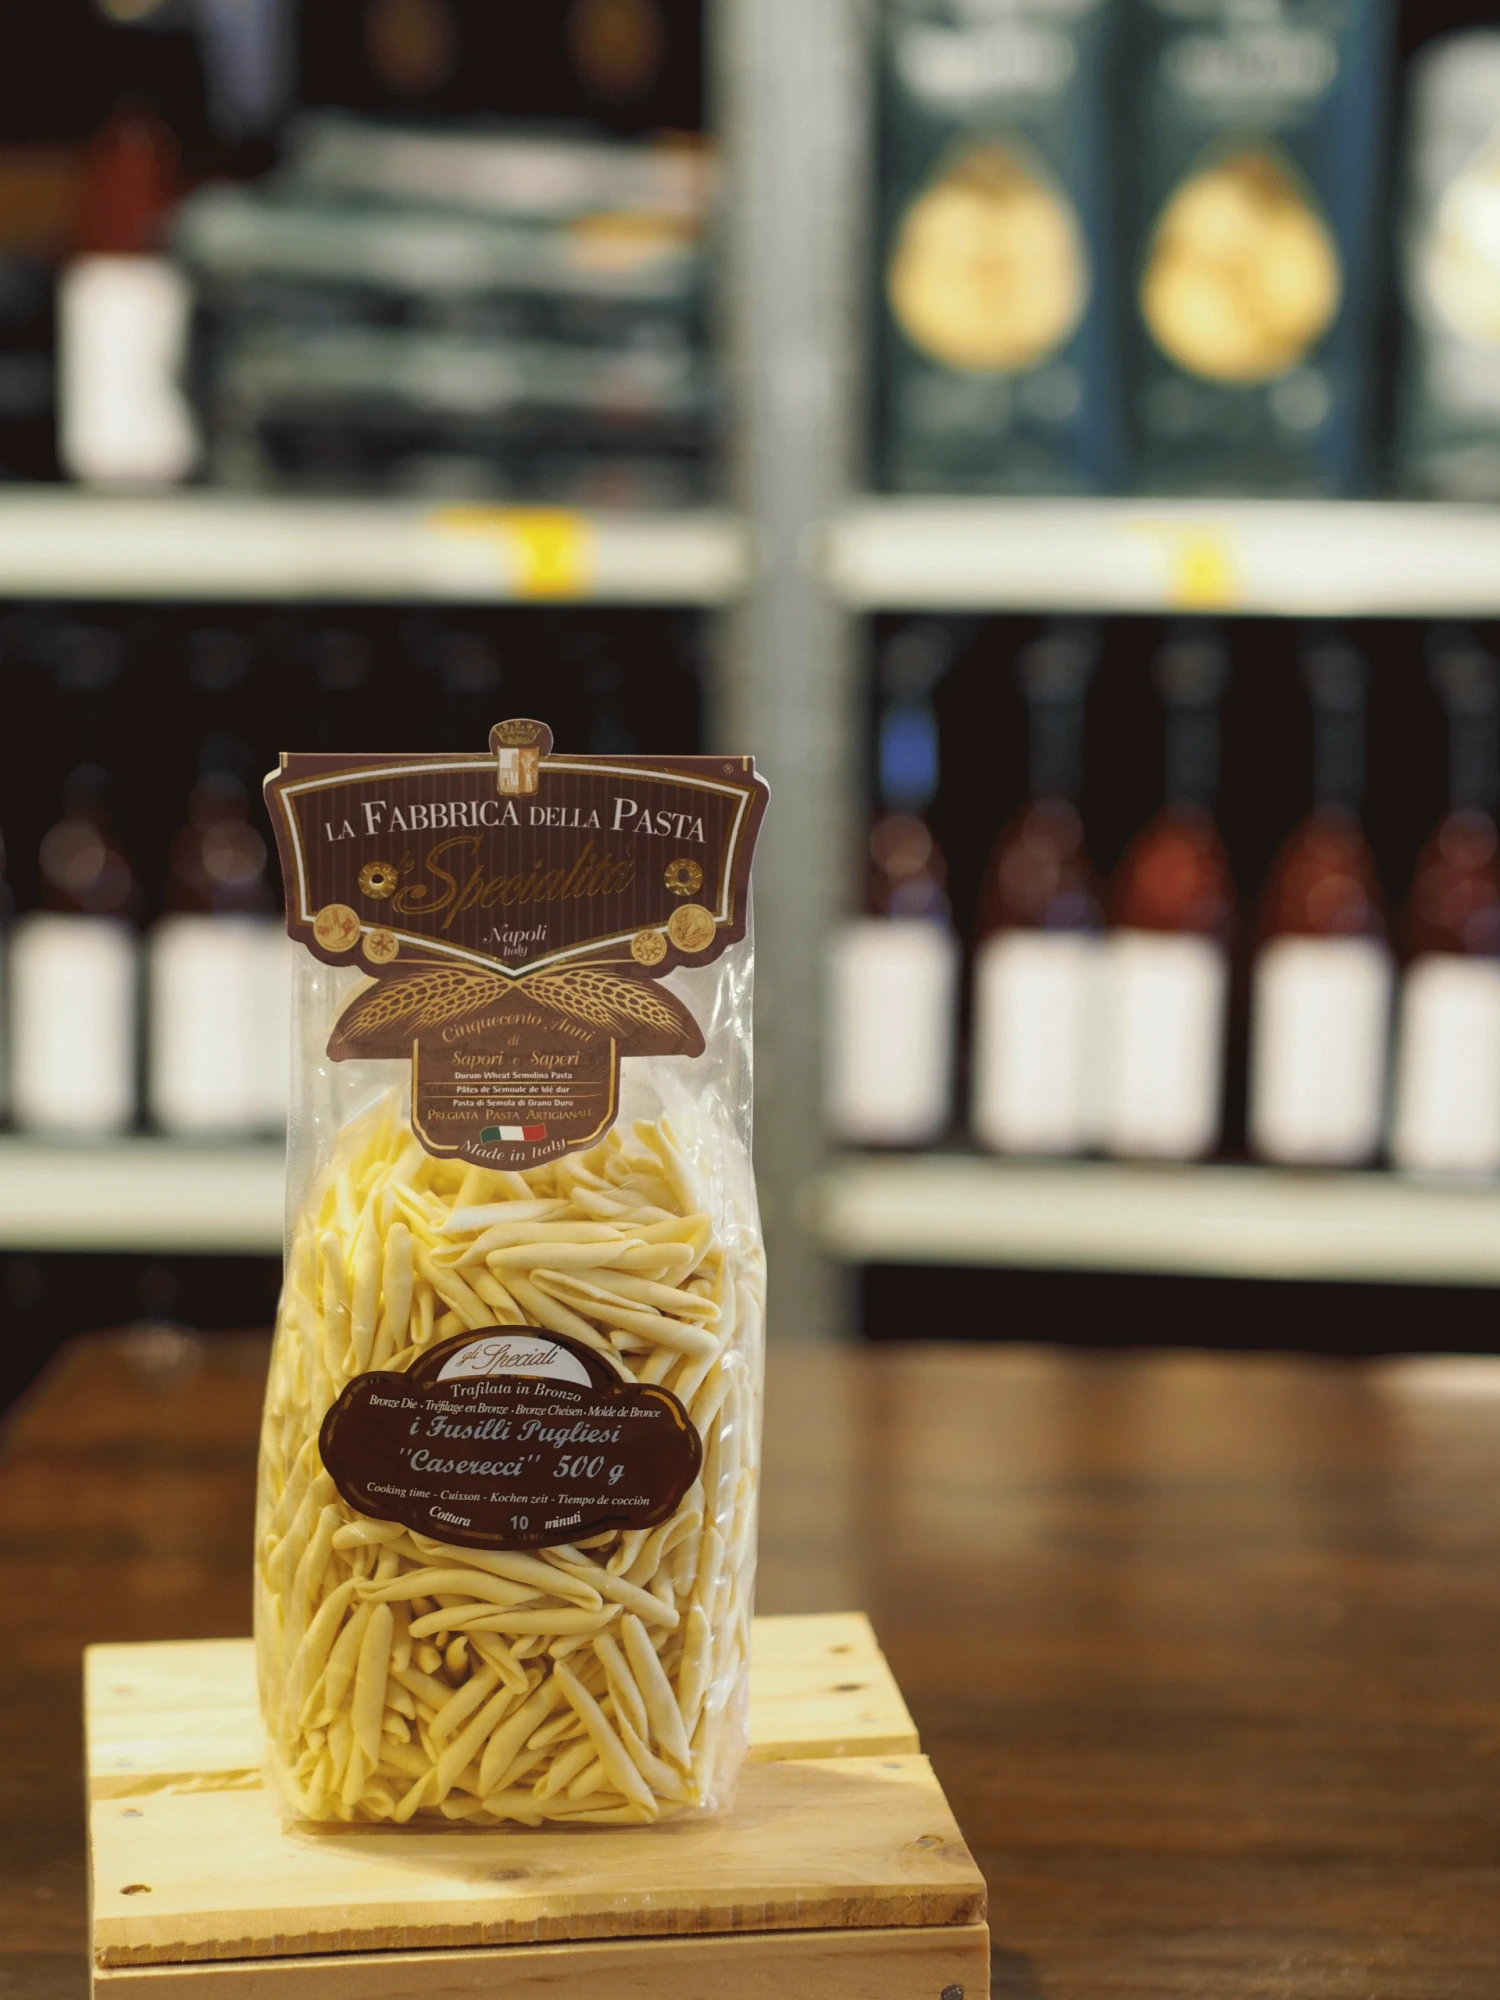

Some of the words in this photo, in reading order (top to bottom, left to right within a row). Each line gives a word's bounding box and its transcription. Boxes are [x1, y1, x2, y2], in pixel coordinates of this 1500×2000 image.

[324, 819, 356, 842] LA
[361, 800, 521, 836] FABBRICA
[529, 806, 602, 829] DELLA
[609, 797, 707, 844] PASTA
[483, 923, 548, 947] Napoli
[503, 944, 528, 958] Italy
[442, 1013, 542, 1043] Cinquecento
[507, 1034, 520, 1046] di
[453, 1051, 504, 1070] Sapori
[512, 1056, 521, 1065] e
[531, 1051, 580, 1070] Saperi
[454, 1071, 482, 1079] Durum
[484, 1071, 510, 1079] Wheat
[512, 1071, 549, 1079] Semolina
[551, 1071, 573, 1079] Pasta
[456, 1085, 479, 1093] Pâtes
[480, 1085, 491, 1093] de
[493, 1085, 527, 1093] Semoule
[529, 1085, 539, 1093] de
[541, 1085, 554, 1093] blé
[555, 1085, 570, 1093] dur
[427, 1109, 479, 1120] PREGIATA
[485, 1109, 520, 1120] PASTA
[453, 1099, 475, 1107] Pasta
[476, 1099, 485, 1107] di
[486, 1099, 516, 1107] Semola
[517, 1099, 526, 1107] di
[528, 1099, 552, 1107] Grano
[554, 1099, 574, 1107] Duro
[460, 1139, 505, 1161] Made
[510, 1149, 525, 1162] in
[532, 1138, 566, 1159] Italy
[455, 1344, 483, 1367] gli
[472, 1343, 563, 1376] Speciali
[450, 1381, 512, 1400] Trafilata
[516, 1382, 530, 1395] in
[533, 1382, 582, 1402] Bronzo
[369, 1394, 400, 1409] Bronze
[401, 1397, 418, 1409] Die
[425, 1399, 464, 1415] Tréfilage
[464, 1404, 477, 1413] en
[477, 1402, 509, 1414] Bronze
[515, 1403, 546, 1416] Bronze
[587, 1405, 617, 1417] Molde
[617, 1406, 629, 1417] de
[629, 1406, 661, 1418] Bronce
[409, 1416, 421, 1435] i
[426, 1415, 513, 1440] Fusilli
[517, 1418, 623, 1448] Pugliesi
[553, 1455, 605, 1478] 500
[608, 1464, 626, 1486] g
[366, 1481, 407, 1498] Cooking
[409, 1487, 432, 1498] time
[440, 1489, 481, 1501] Cuisson
[490, 1491, 528, 1503] Kochen
[530, 1493, 549, 1504] zeit
[558, 1494, 595, 1507] Tiempo
[596, 1495, 609, 1505] de
[429, 1505, 472, 1527] Cottura
[510, 1515, 529, 1530] 10
[545, 1510, 581, 1530] minuti
